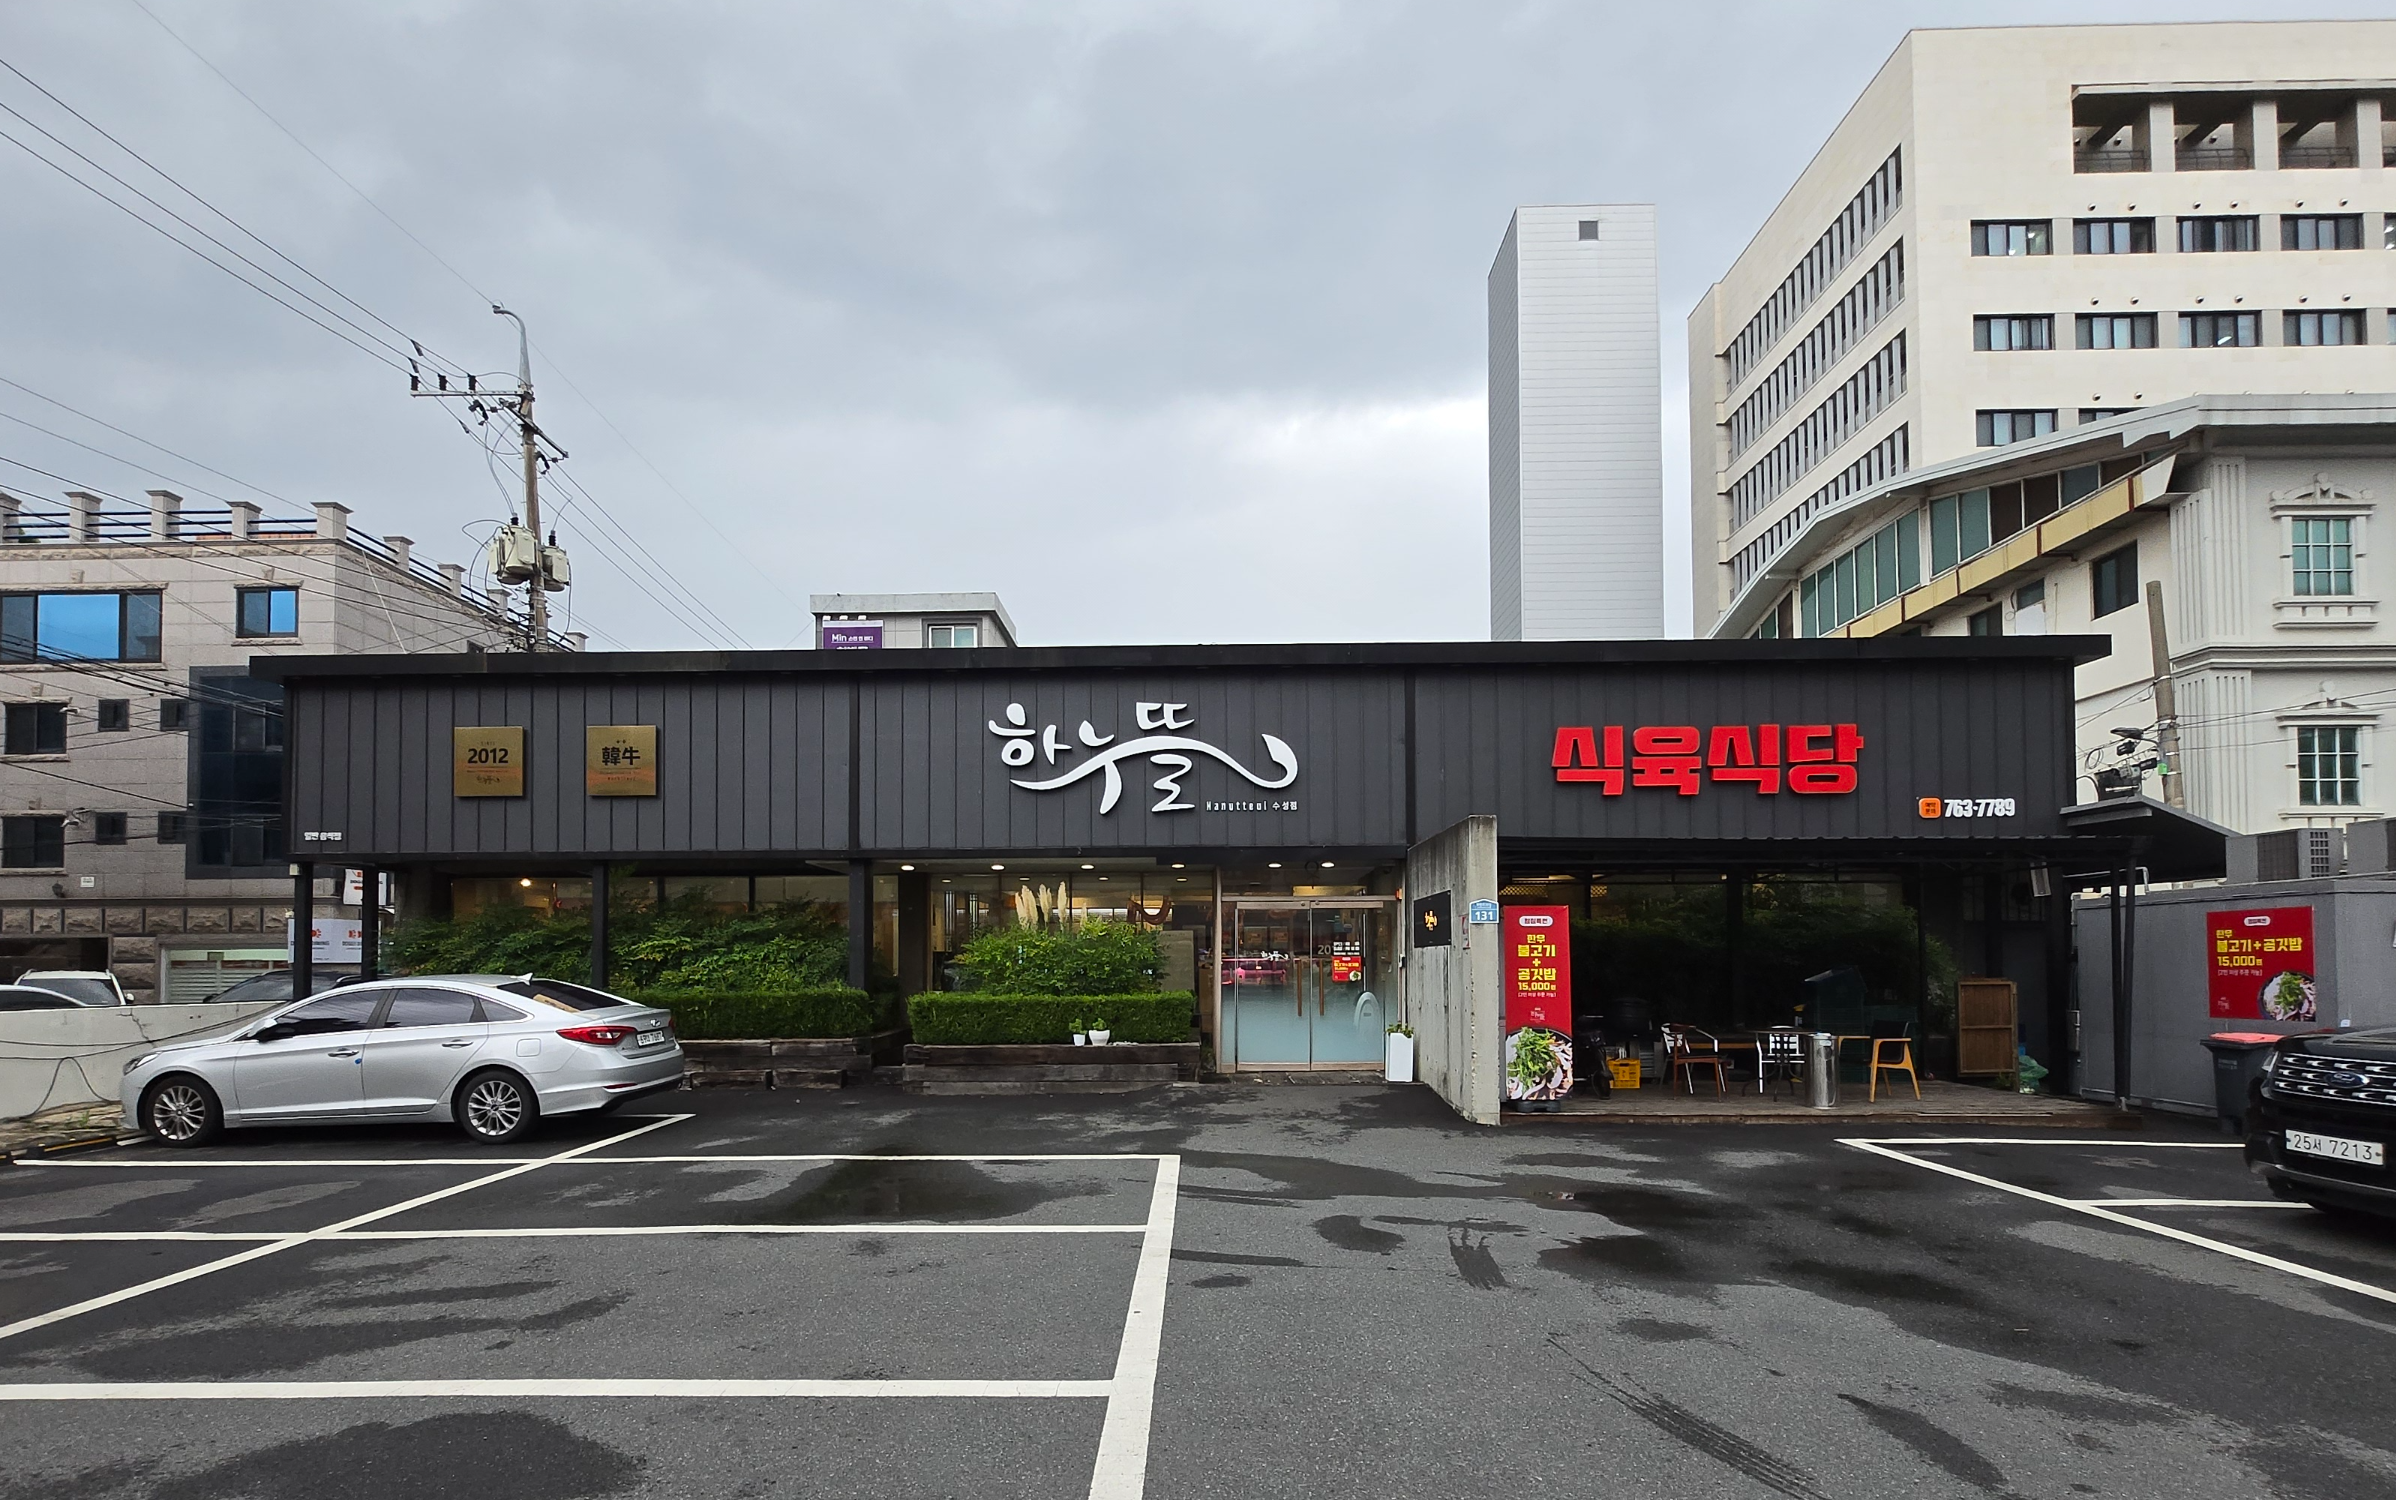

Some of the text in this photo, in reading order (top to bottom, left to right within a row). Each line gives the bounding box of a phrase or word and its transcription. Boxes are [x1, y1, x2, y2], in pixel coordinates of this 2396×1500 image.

[831, 633, 847, 642] Min
[467, 748, 509, 764] 2012
[601, 746, 641, 766] 韓牛
[1551, 724, 1864, 795] 식육식당
[1206, 800, 1298, 811] Hanutteul 수성점
[1475, 911, 1494, 921] 131
[1527, 934, 1546, 944] 한우
[2216, 929, 2233, 939] 한우
[1517, 944, 1556, 957] 불고기
[1517, 968, 1557, 981] 공깃밥
[2293, 1134, 2373, 1160] 25서 7213
